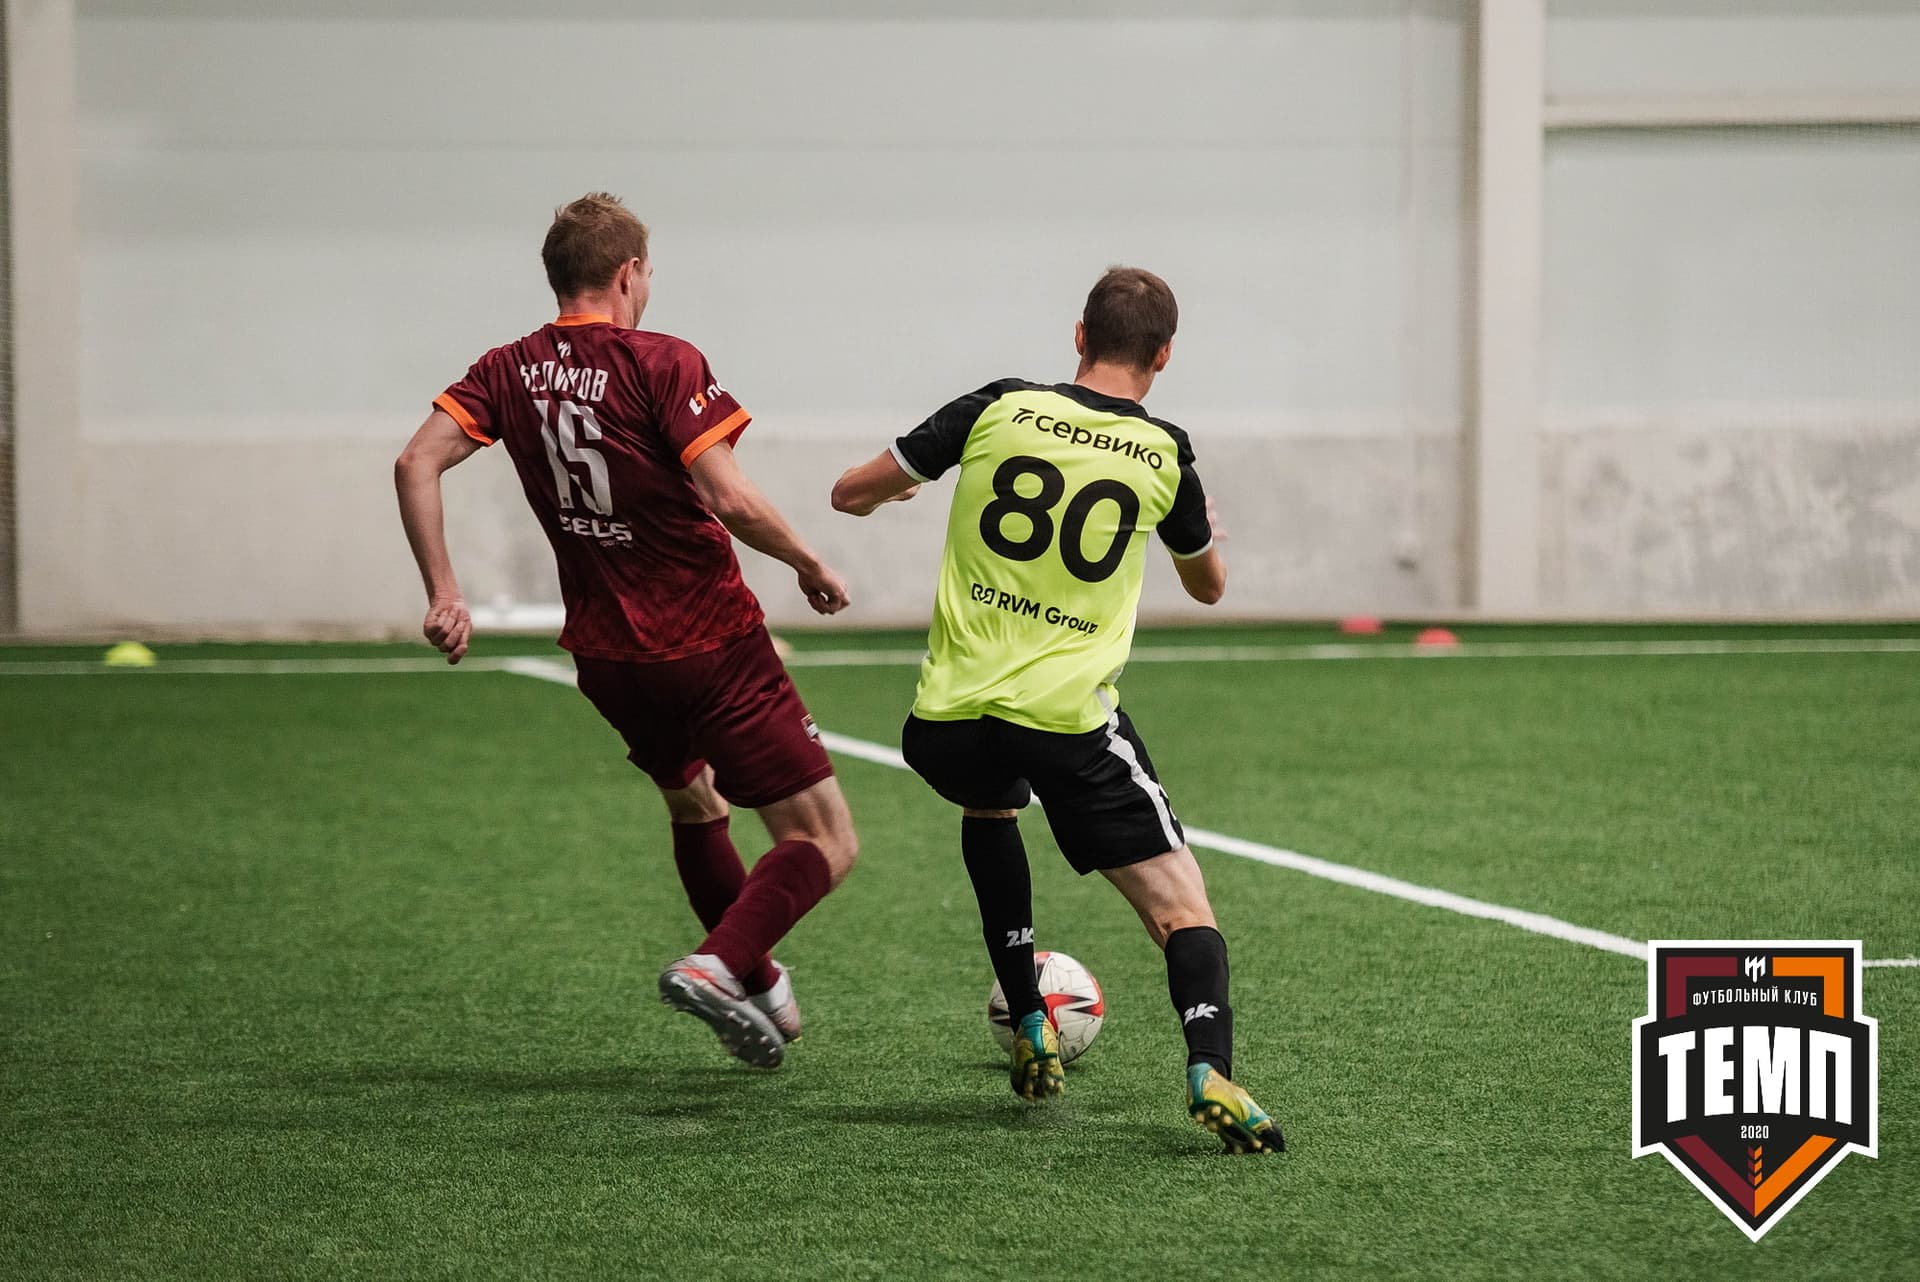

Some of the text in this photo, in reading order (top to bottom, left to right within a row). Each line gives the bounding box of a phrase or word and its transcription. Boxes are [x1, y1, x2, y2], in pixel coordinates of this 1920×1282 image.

[533, 399, 613, 517] 15
[559, 514, 633, 541] SELS
[980, 455, 1140, 583] 80
[997, 591, 1098, 637] RVM Group
[1005, 927, 1034, 948] 2K
[1184, 1002, 1219, 1026] 2K
